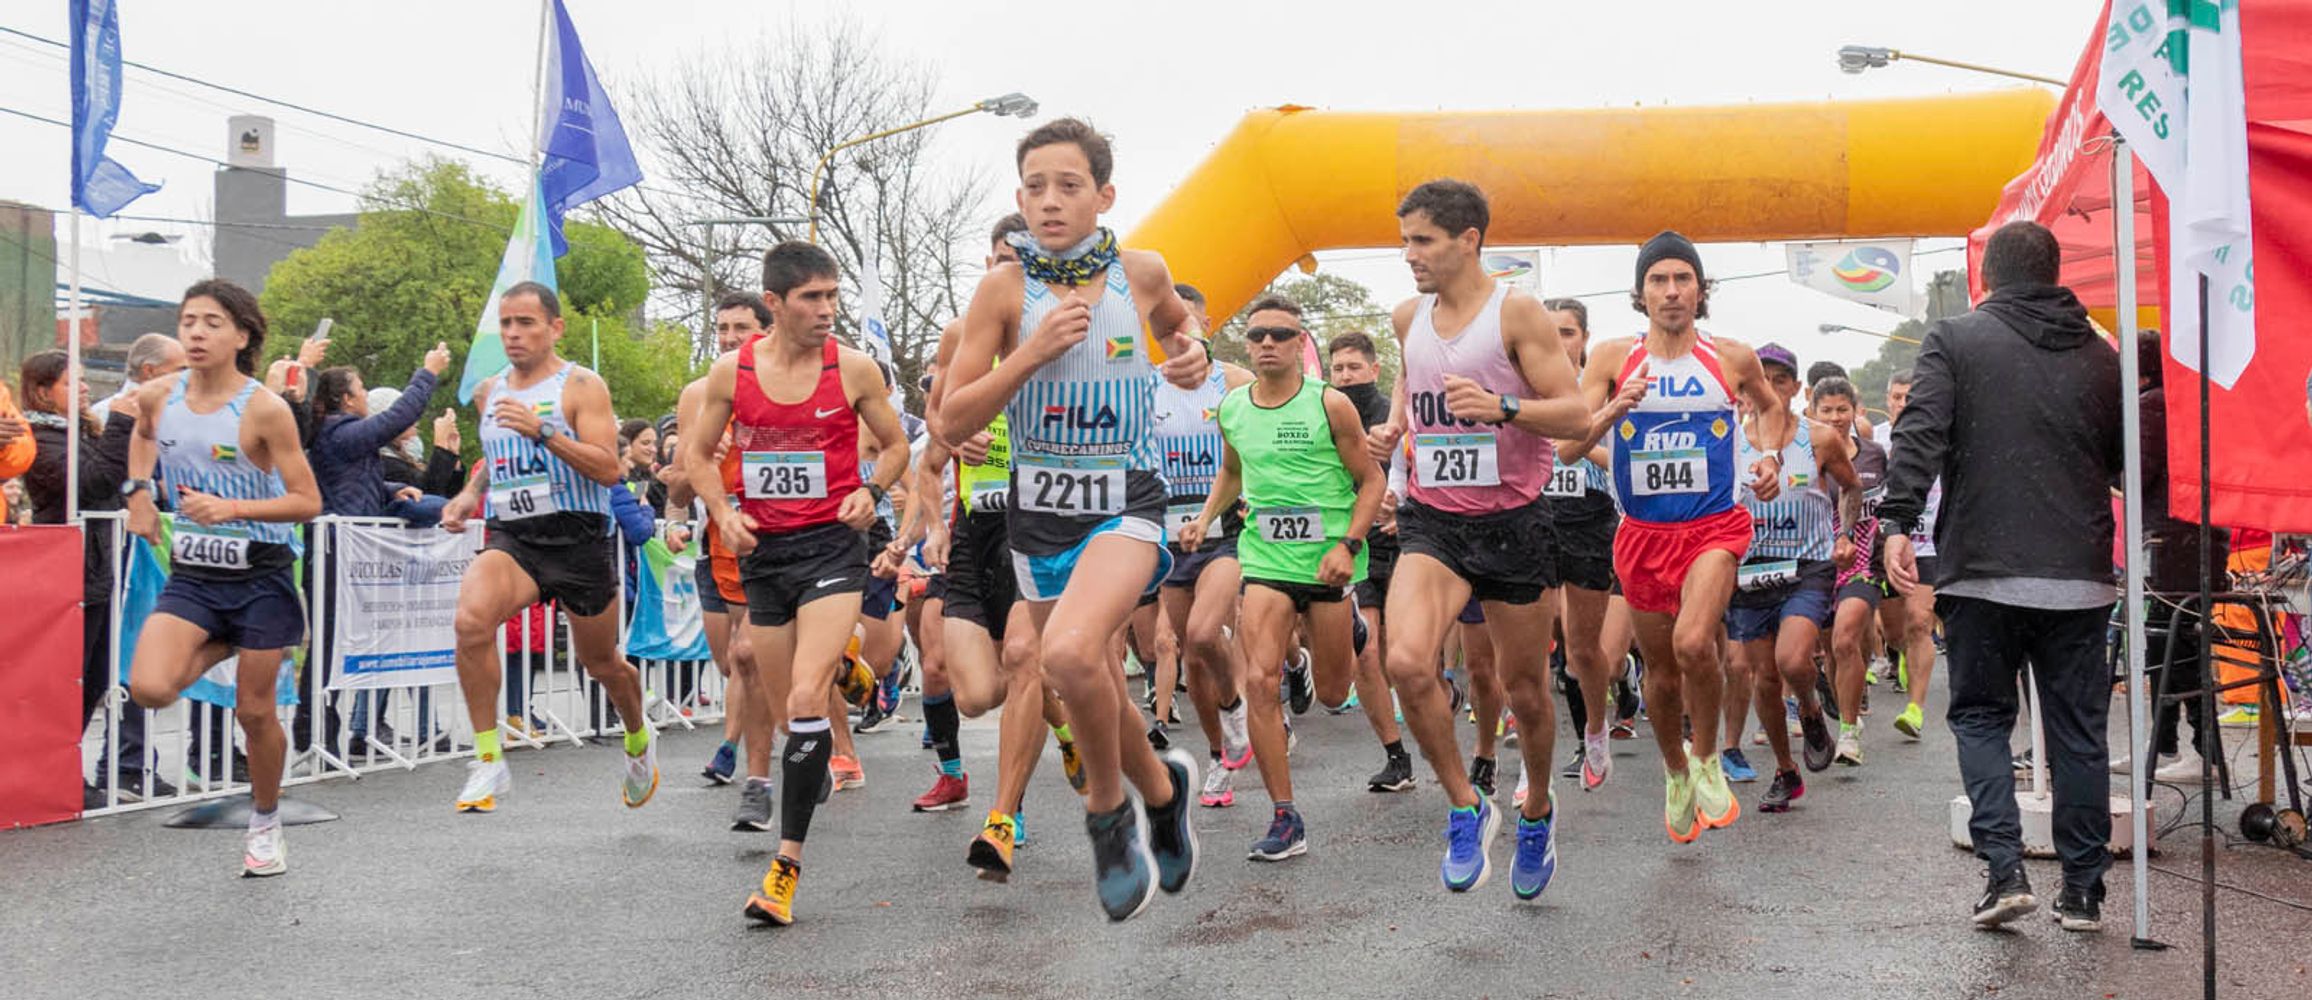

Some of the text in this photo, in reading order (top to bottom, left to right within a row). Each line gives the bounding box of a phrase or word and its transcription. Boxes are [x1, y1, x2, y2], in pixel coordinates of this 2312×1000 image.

[1646, 376, 1706, 397] FILA
[1043, 404, 1117, 429] FILA
[1412, 391, 1497, 428] FOC
[1277, 431, 1309, 439] BOXEO
[495, 454, 549, 481] FILA
[1167, 450, 1214, 468] FILA
[1433, 449, 1479, 482] 237
[758, 466, 811, 495] 235
[1646, 462, 1694, 491] 844
[510, 489, 535, 514] 40
[1033, 471, 1109, 511] 2211
[1269, 517, 1311, 540] 232
[1755, 516, 1797, 532] FILA
[180, 535, 240, 565] 2406
[350, 561, 402, 579] NICOLAS
